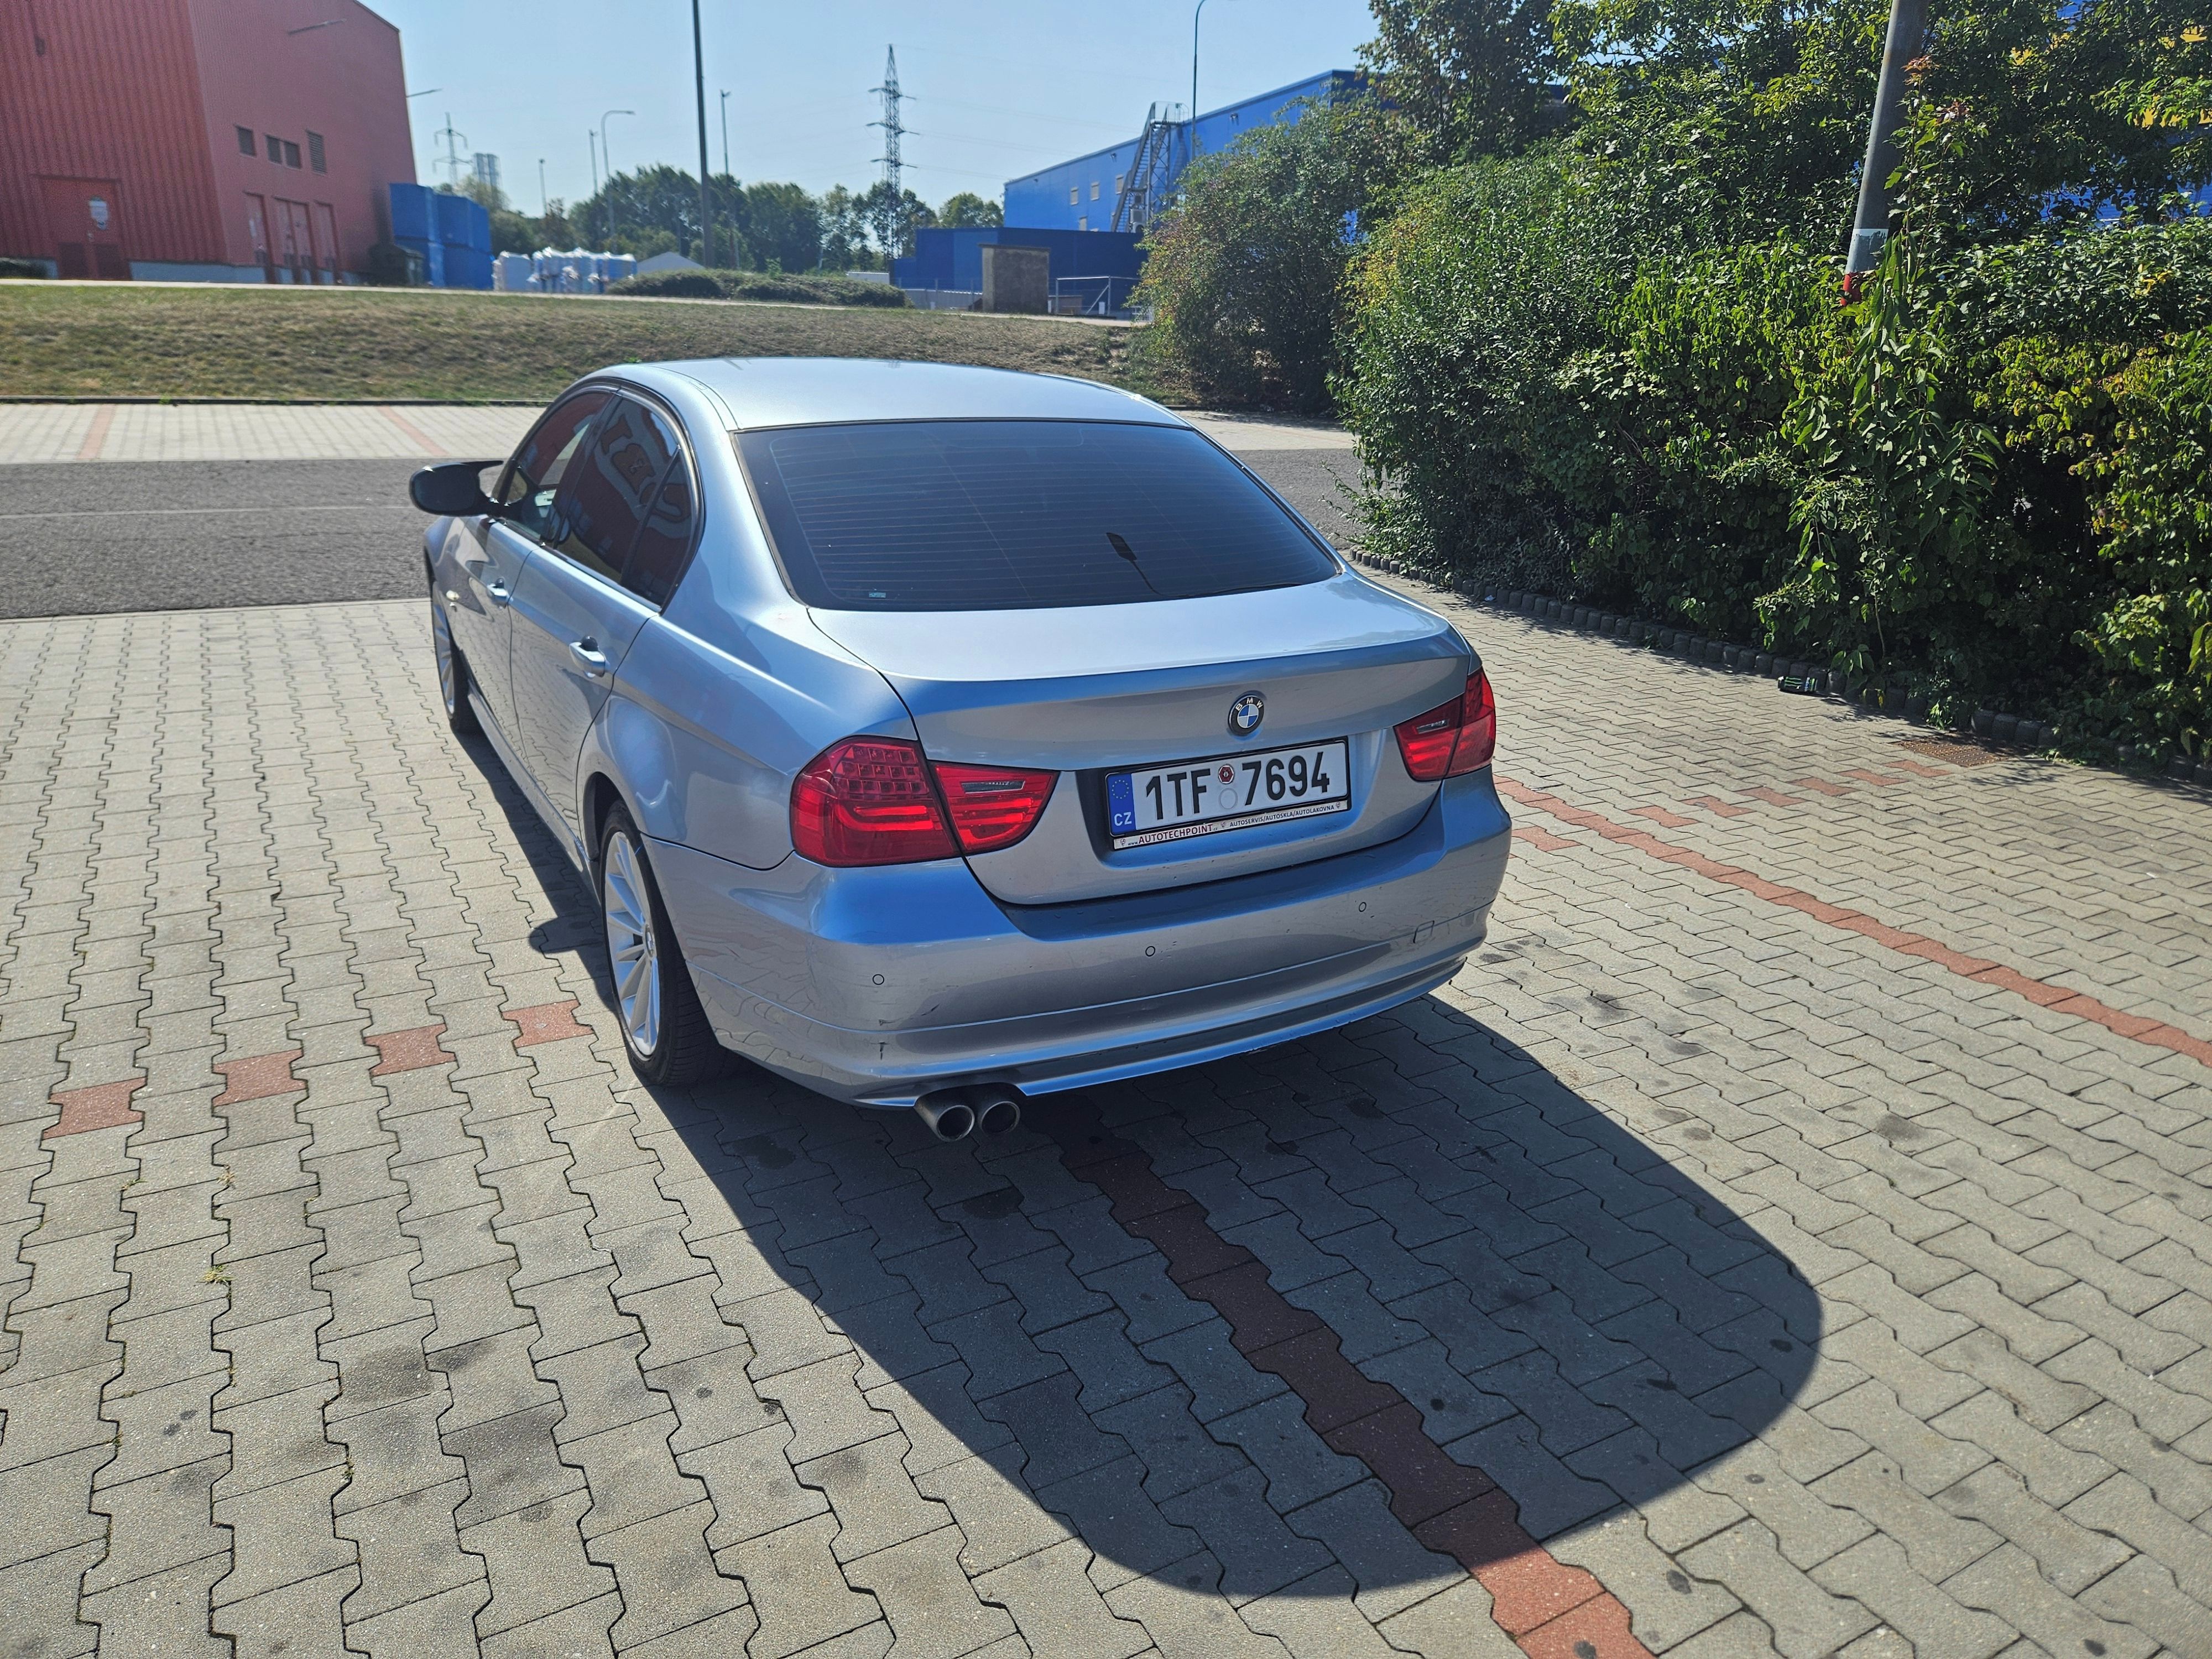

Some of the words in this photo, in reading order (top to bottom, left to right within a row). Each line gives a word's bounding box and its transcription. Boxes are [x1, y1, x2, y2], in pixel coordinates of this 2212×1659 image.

[1235, 697, 1263, 711] BMW
[1146, 768, 1211, 820] 1TF
[1242, 752, 1330, 806] 7694
[1114, 812, 1132, 826] CZ
